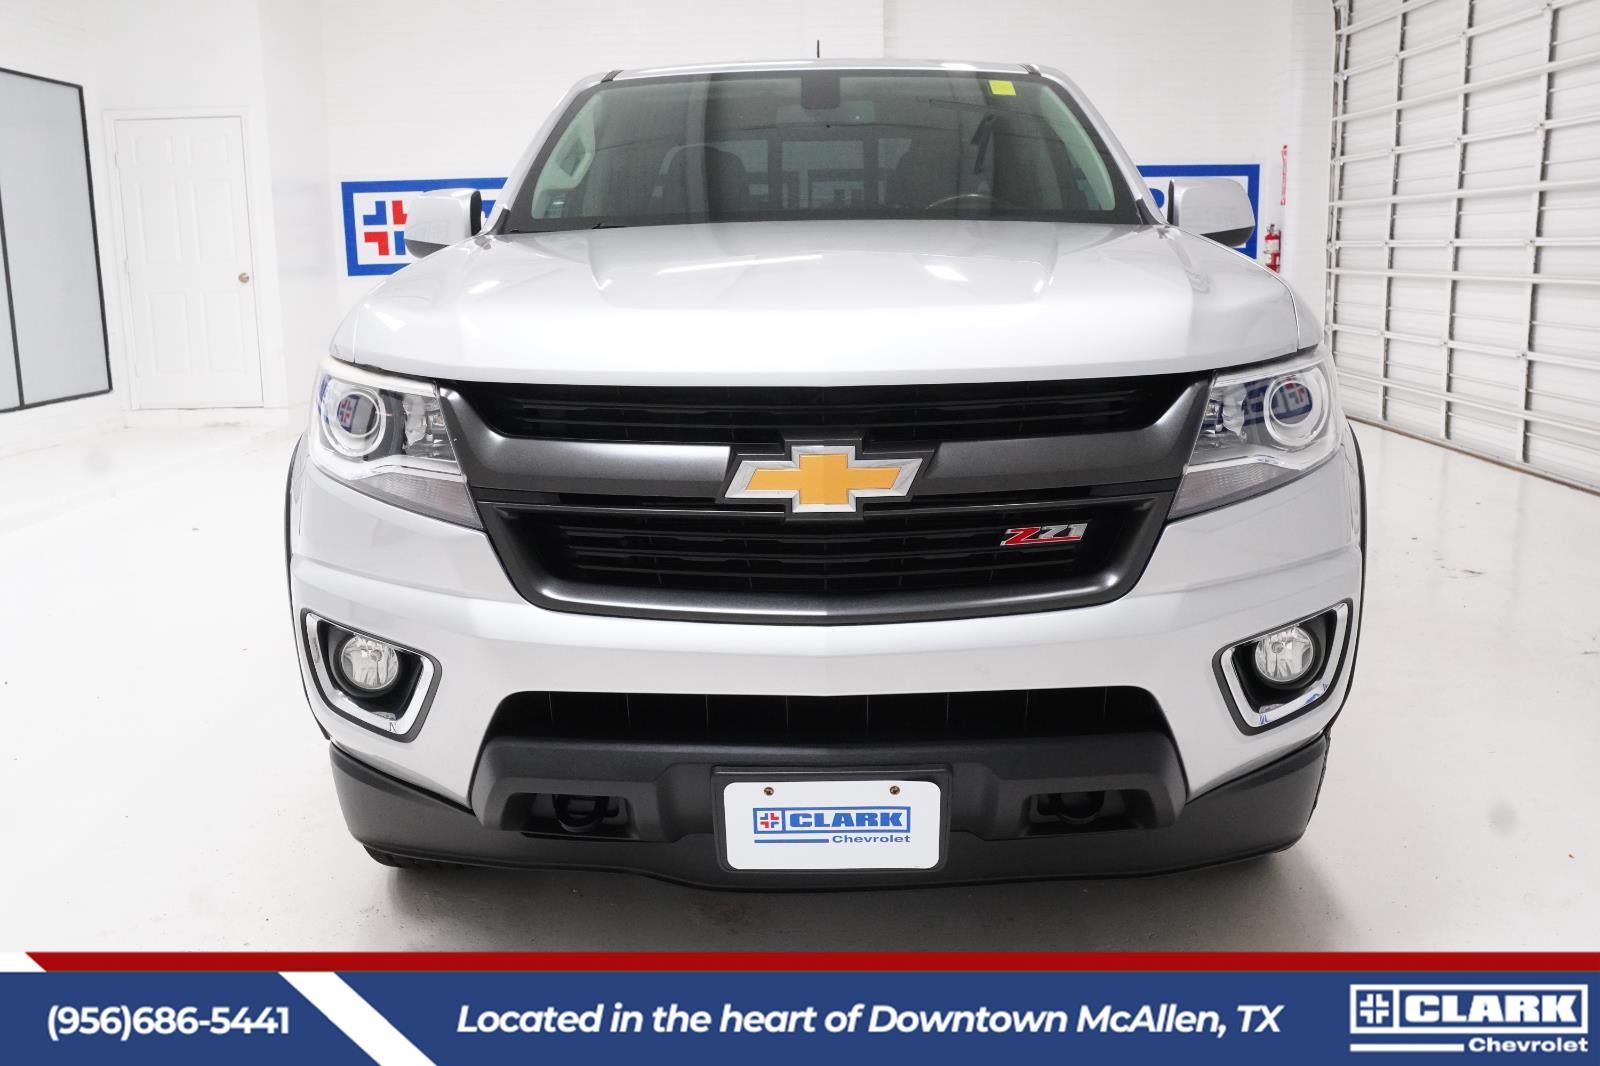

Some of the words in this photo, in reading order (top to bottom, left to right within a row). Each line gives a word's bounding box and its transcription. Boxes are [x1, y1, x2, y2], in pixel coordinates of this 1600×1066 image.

[1000, 523, 1088, 546] Z71
[789, 812, 903, 828] CLARK
[832, 834, 911, 843] Chevrolet
